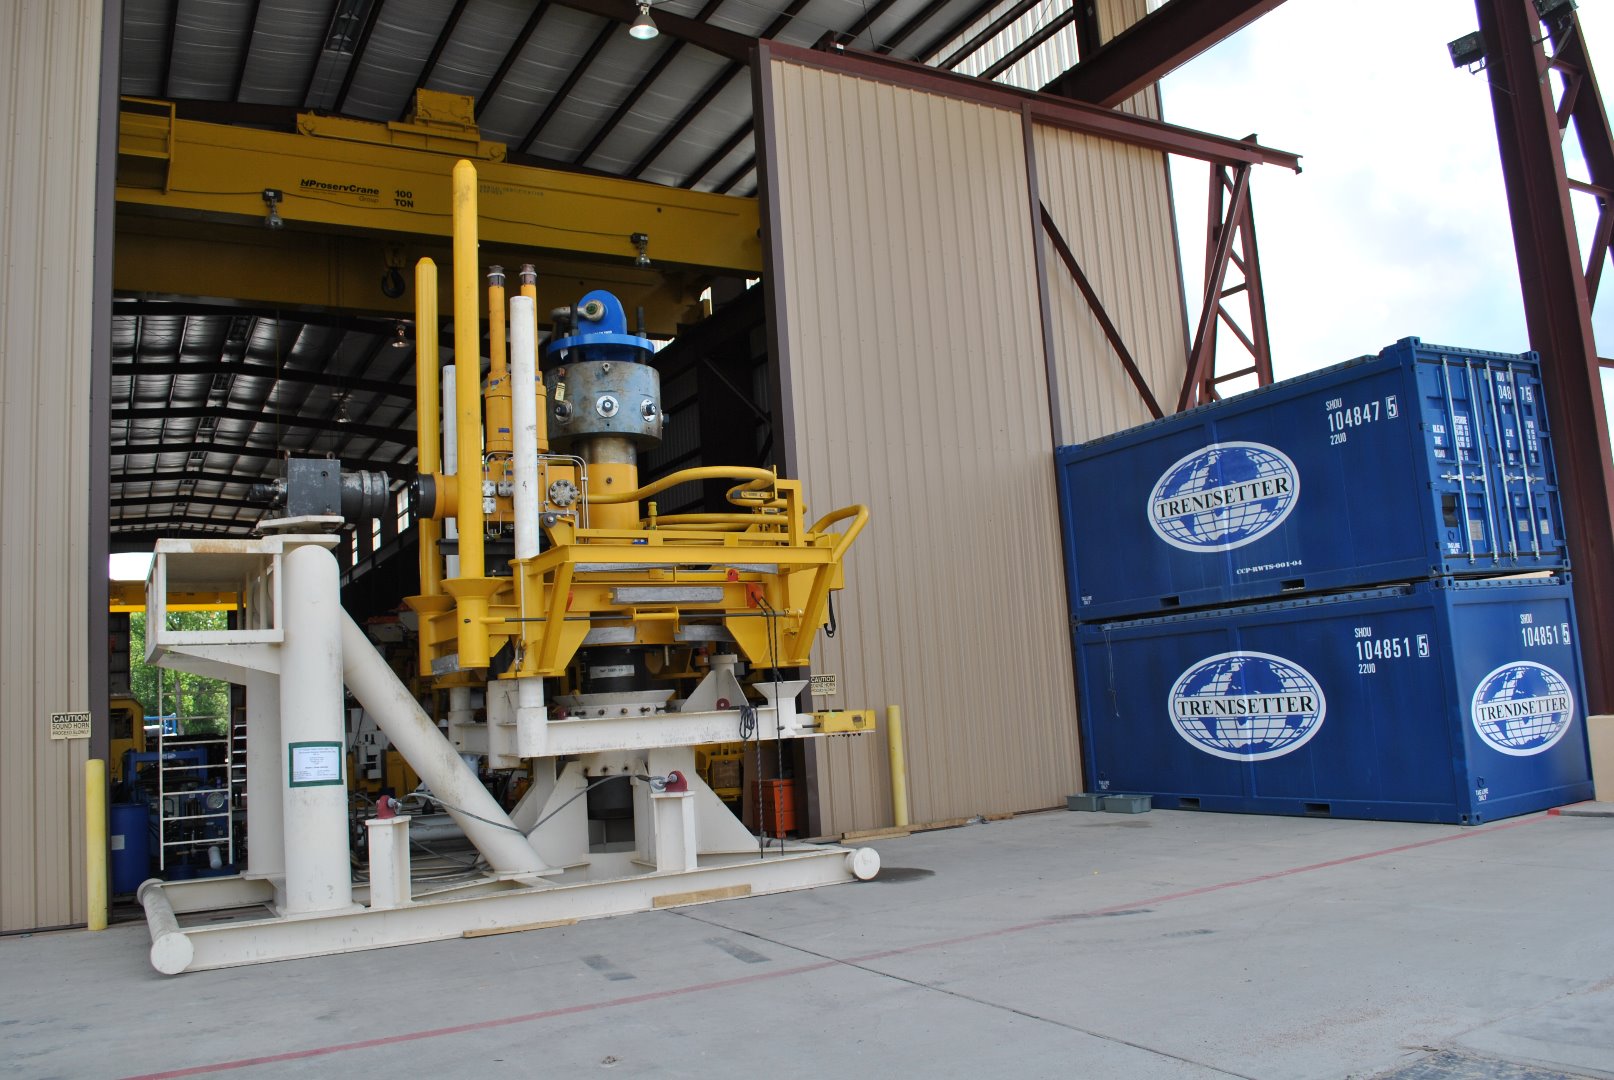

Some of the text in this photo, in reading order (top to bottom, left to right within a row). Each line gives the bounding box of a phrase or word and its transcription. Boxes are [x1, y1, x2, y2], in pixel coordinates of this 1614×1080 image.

[395, 190, 412, 199] 100
[394, 199, 414, 208] TON
[1325, 397, 1342, 411] SHOU
[1327, 396, 1398, 432] 104847 5
[1520, 613, 1533, 624] SHOU
[1354, 626, 1372, 638] SHOU
[1522, 624, 1570, 647] 104851 5
[1355, 635, 1429, 661] 104851 5
[1478, 696, 1568, 722] TRENDSETTER
[53, 714, 89, 723] CAUTION
